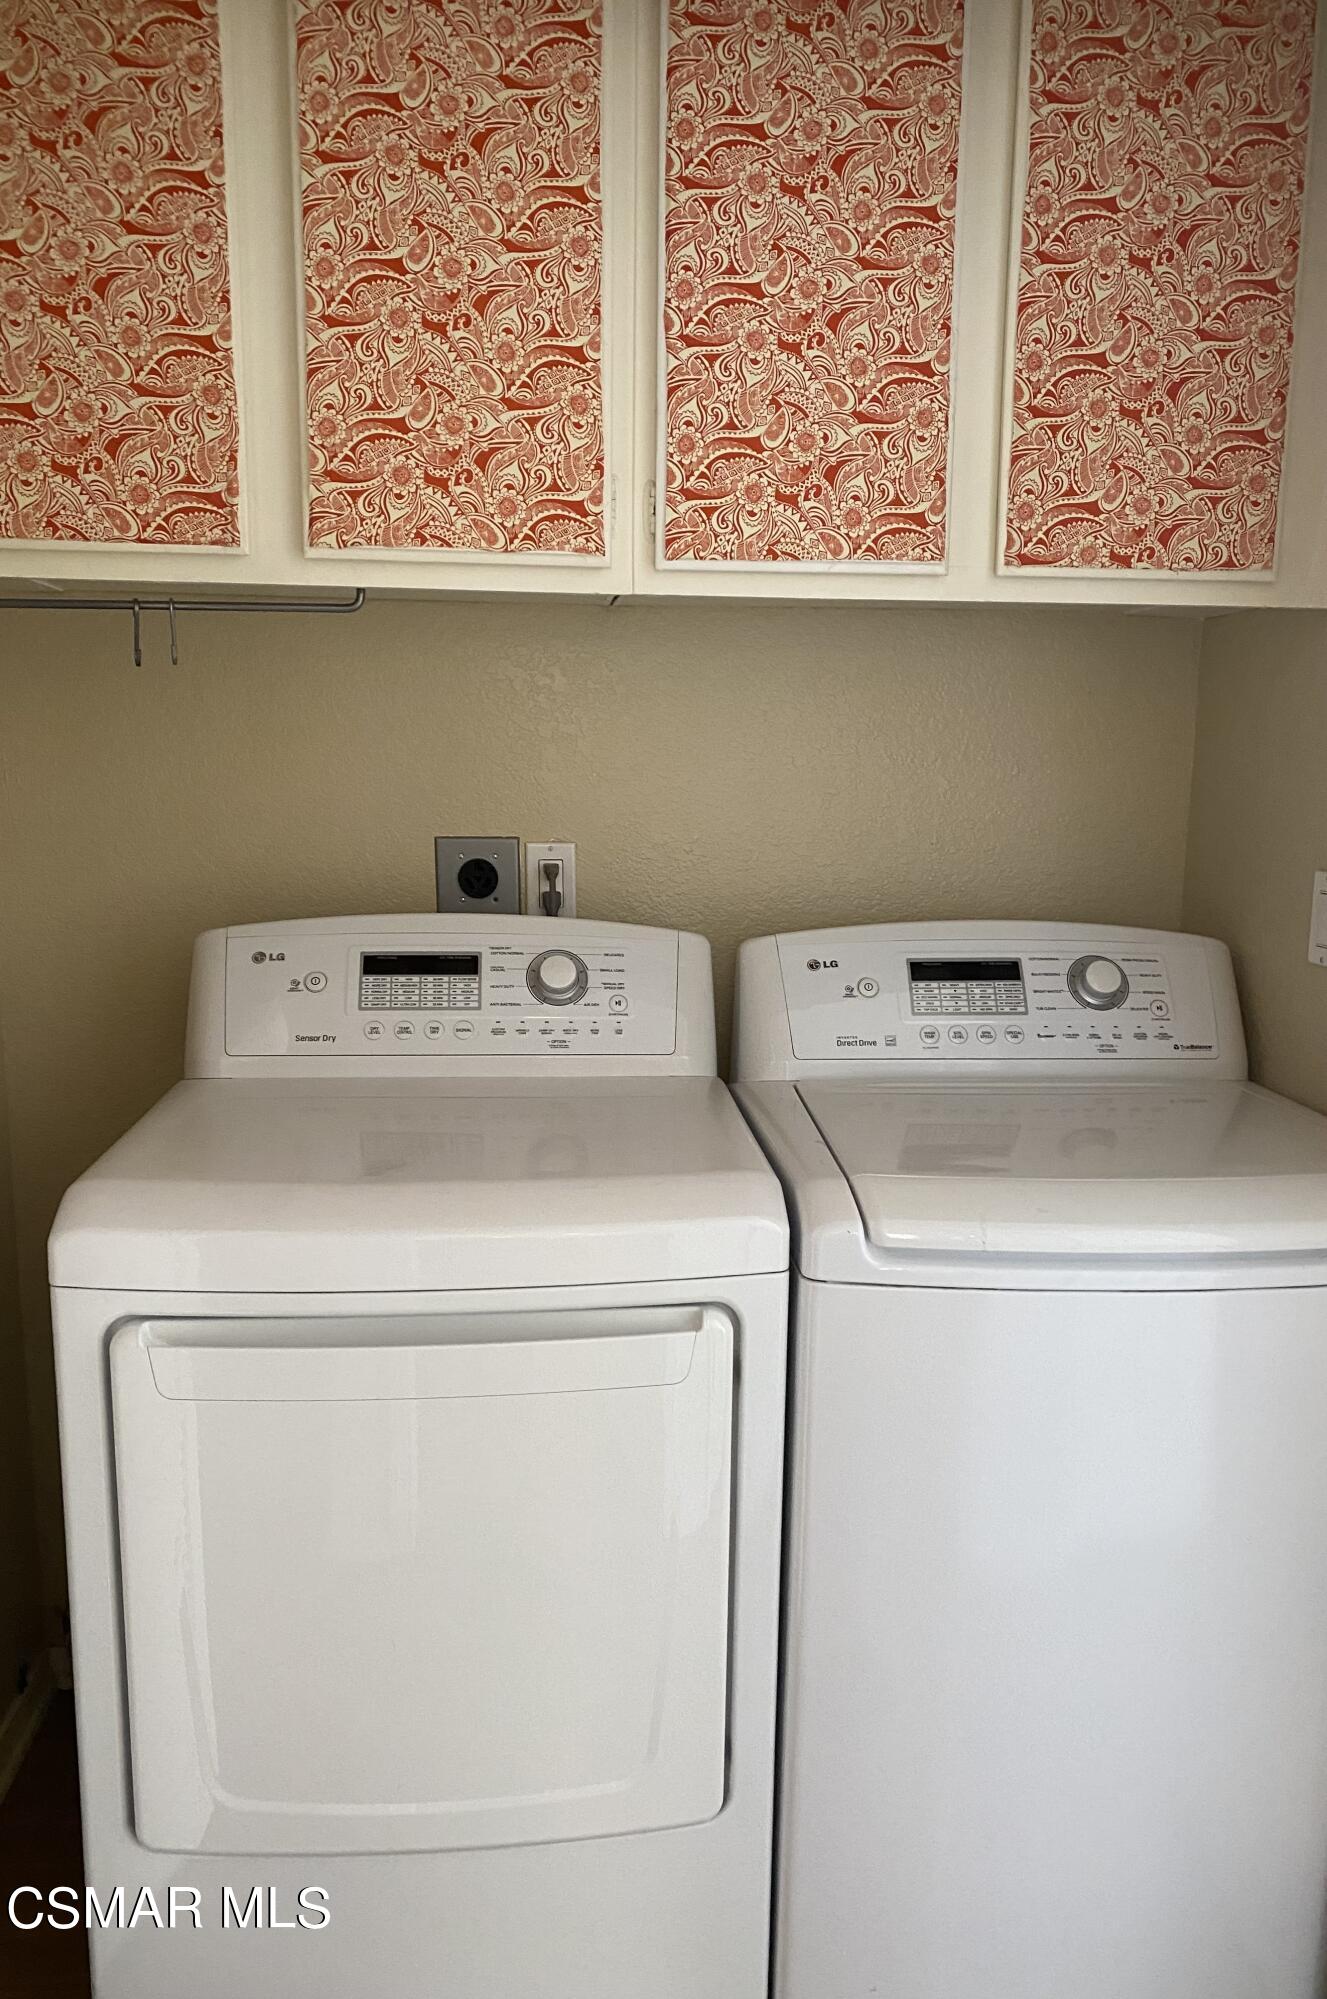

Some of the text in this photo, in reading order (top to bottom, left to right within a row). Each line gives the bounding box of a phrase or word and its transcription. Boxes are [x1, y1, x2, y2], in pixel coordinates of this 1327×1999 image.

[268, 953, 286, 961] LG
[823, 960, 839, 968] LG
[295, 1034, 337, 1043] Sensor Dry
